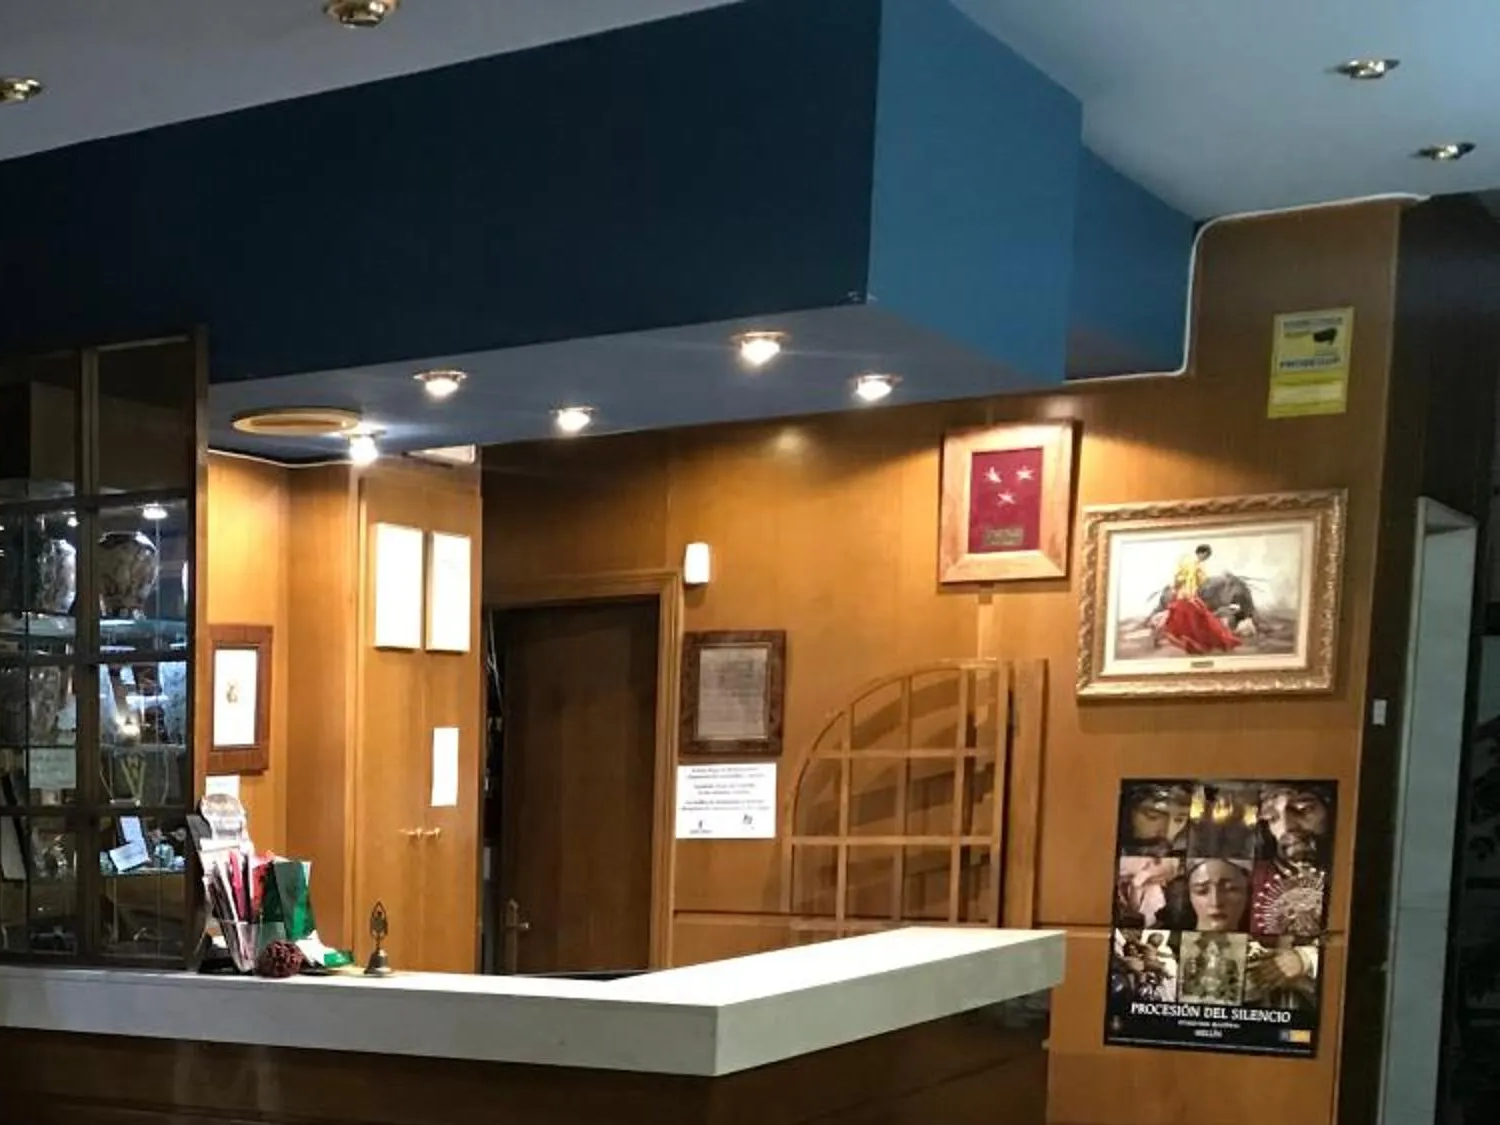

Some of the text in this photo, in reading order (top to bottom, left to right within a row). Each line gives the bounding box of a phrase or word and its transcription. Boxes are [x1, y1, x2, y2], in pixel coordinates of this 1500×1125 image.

[1131, 1002, 1291, 1023] PROCESIÓN DEL SILENCIO
